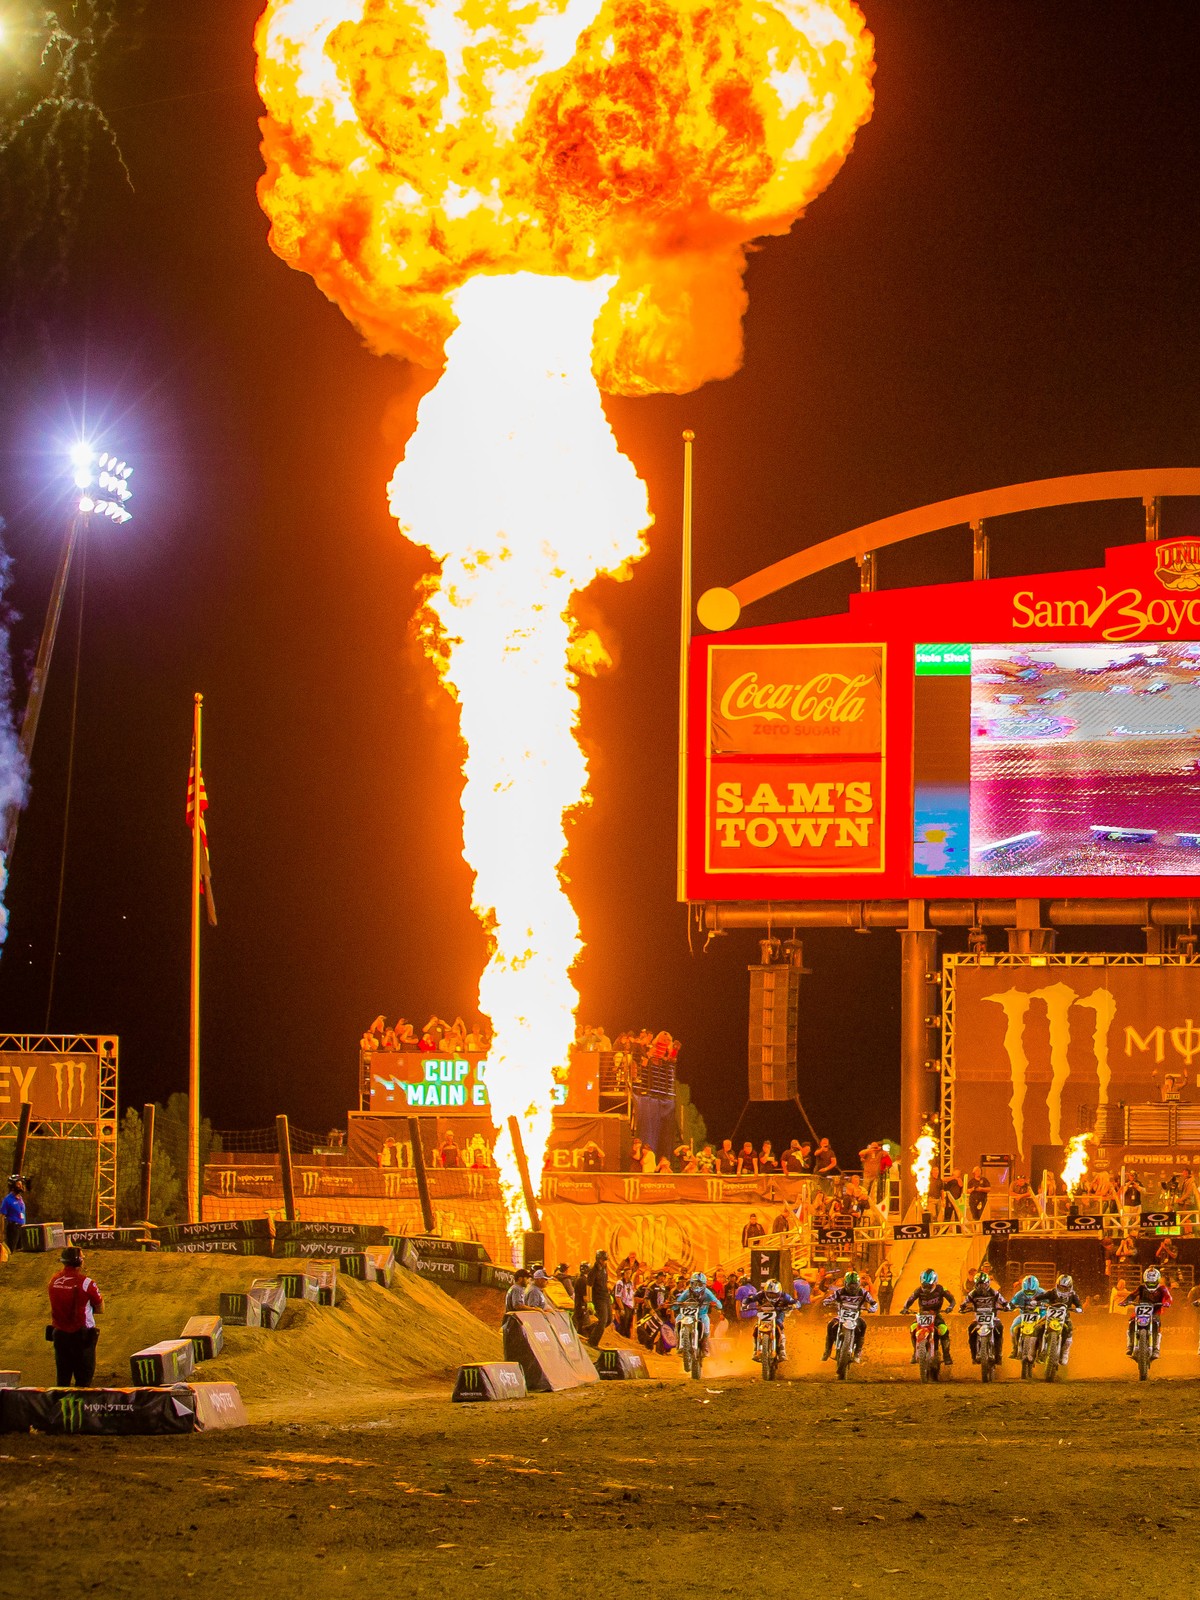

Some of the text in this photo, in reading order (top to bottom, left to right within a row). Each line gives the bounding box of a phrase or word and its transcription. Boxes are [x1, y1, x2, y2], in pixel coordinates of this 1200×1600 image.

[916, 653, 969, 663] Hole Shot
[720, 671, 876, 722] Coca-Cola
[753, 724, 841, 736] zero SUGAR
[716, 782, 873, 813] SAM'S
[716, 817, 873, 848] TOWN
[425, 1060, 469, 1081] CUP
[407, 1085, 465, 1106] MAIN
[1123, 1154, 1173, 1164] OCTOBER
[1176, 1154, 1190, 1165] 13,
[183, 1222, 239, 1235] MONSTER
[304, 1223, 356, 1235] MONSTER
[69, 1231, 115, 1242] ONSTER
[177, 1241, 237, 1253] MONSTER
[300, 1243, 355, 1254] MONSTER
[416, 1260, 455, 1273] ONSTER
[1136, 1306, 1152, 1315] 62
[761, 1312, 774, 1322] 2
[978, 1315, 993, 1323] 60
[1022, 1314, 1038, 1322] 114
[83, 1402, 134, 1413] MONSTER
